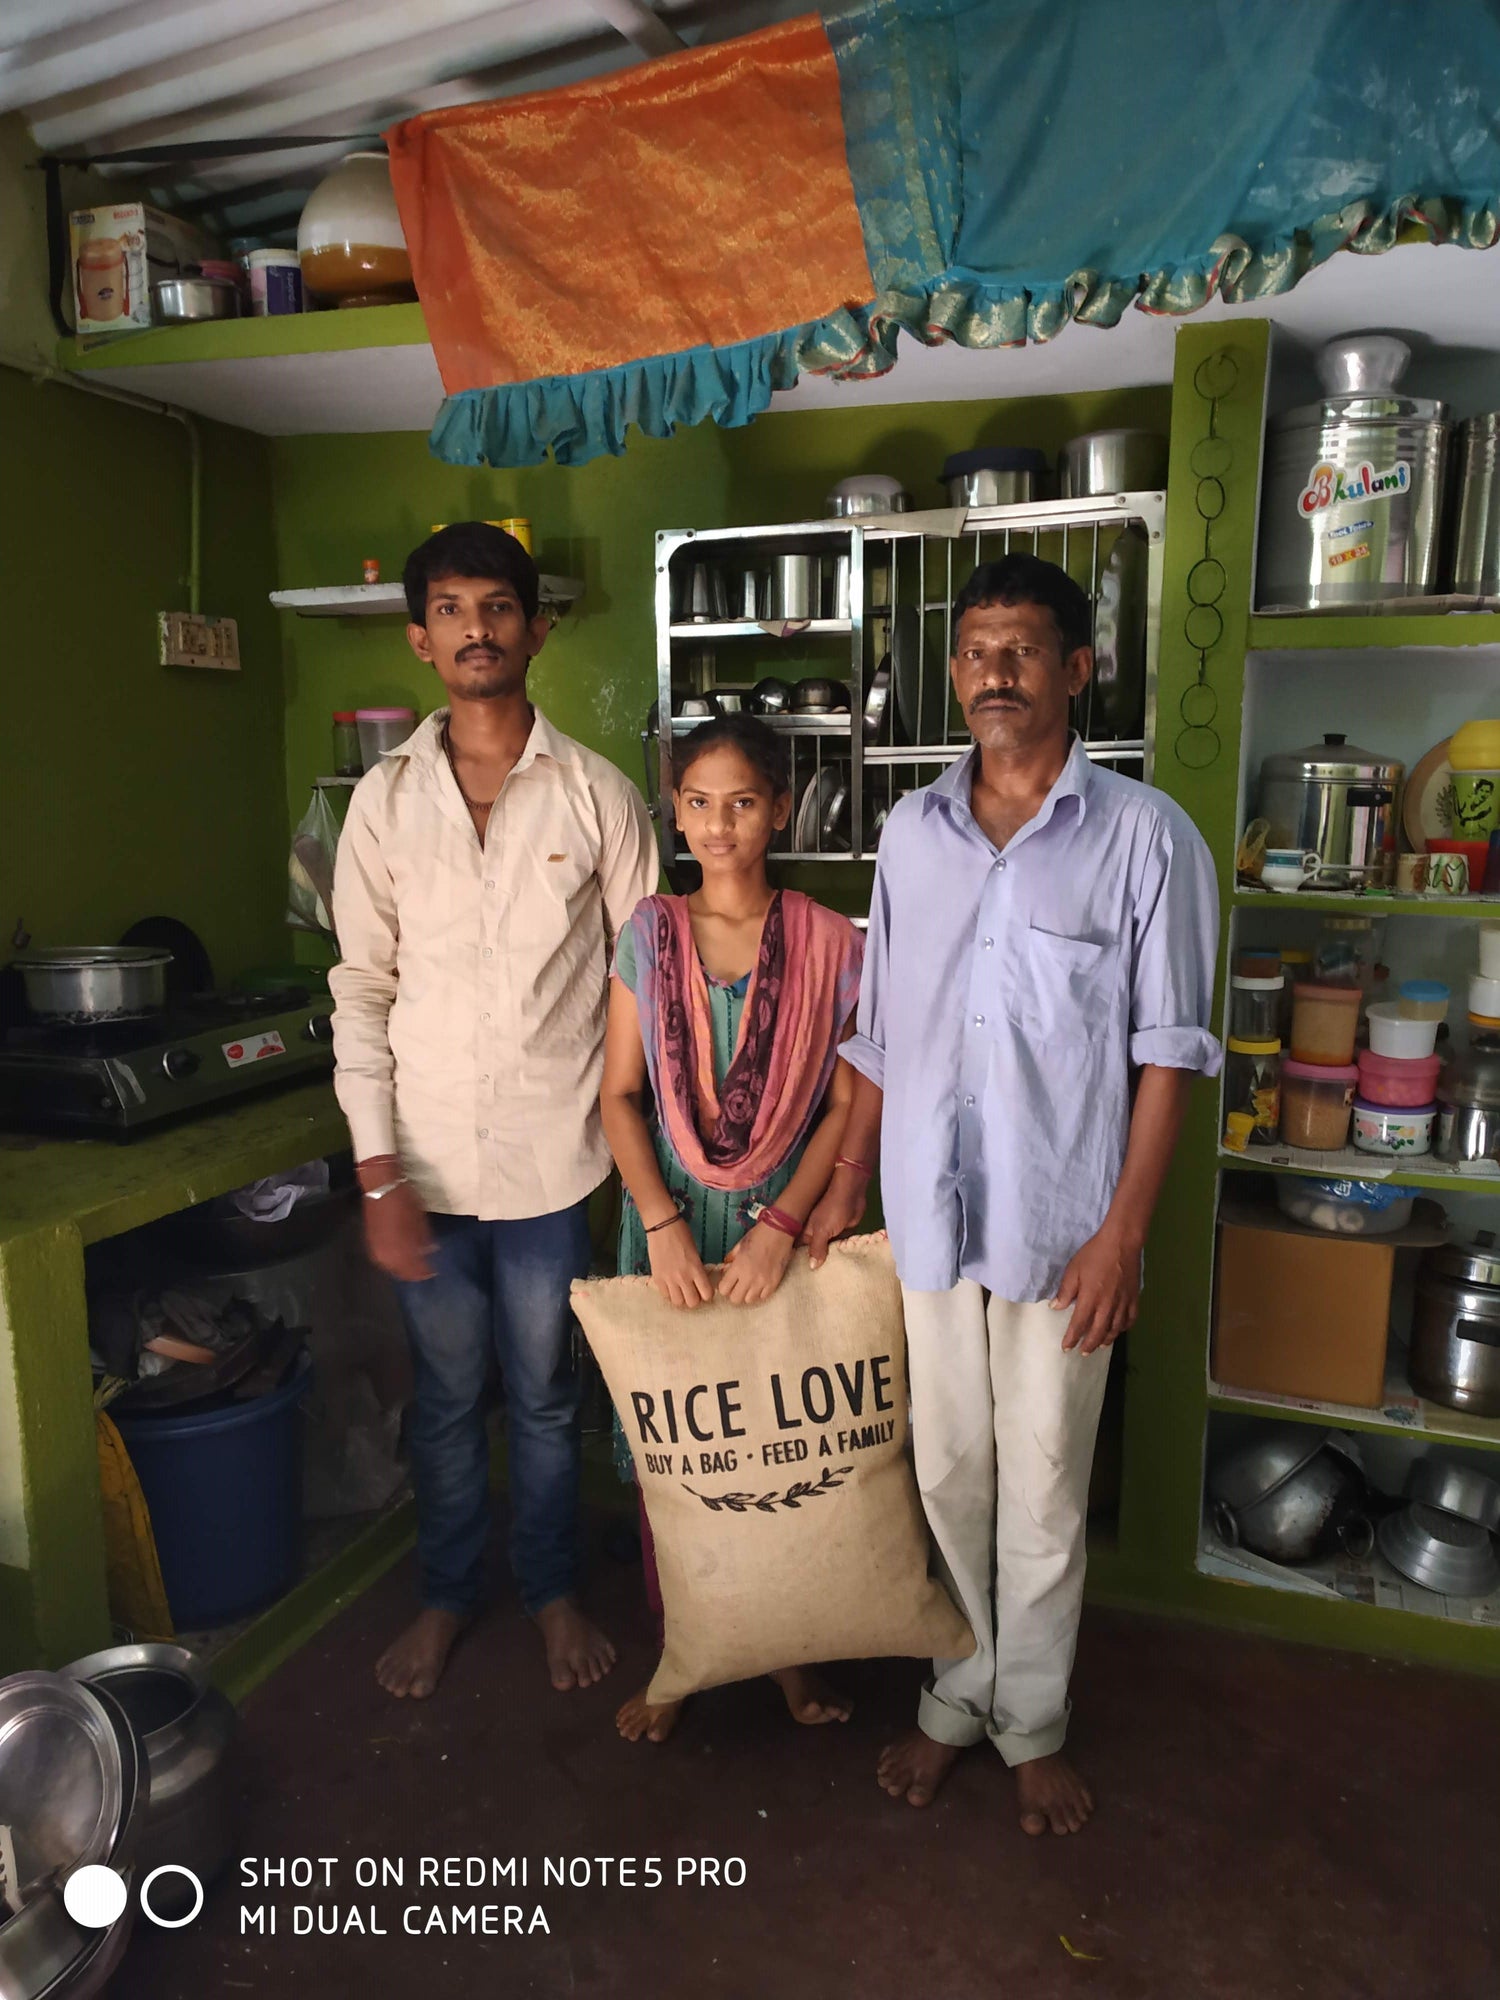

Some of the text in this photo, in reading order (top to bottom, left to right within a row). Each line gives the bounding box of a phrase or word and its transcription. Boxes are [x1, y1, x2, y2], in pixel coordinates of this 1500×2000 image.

[1302, 465, 1406, 512] Bhulani
[630, 1355, 895, 1444] RICE LOVE
[645, 1418, 896, 1475] BUY A BAG FEED A FAMILY
